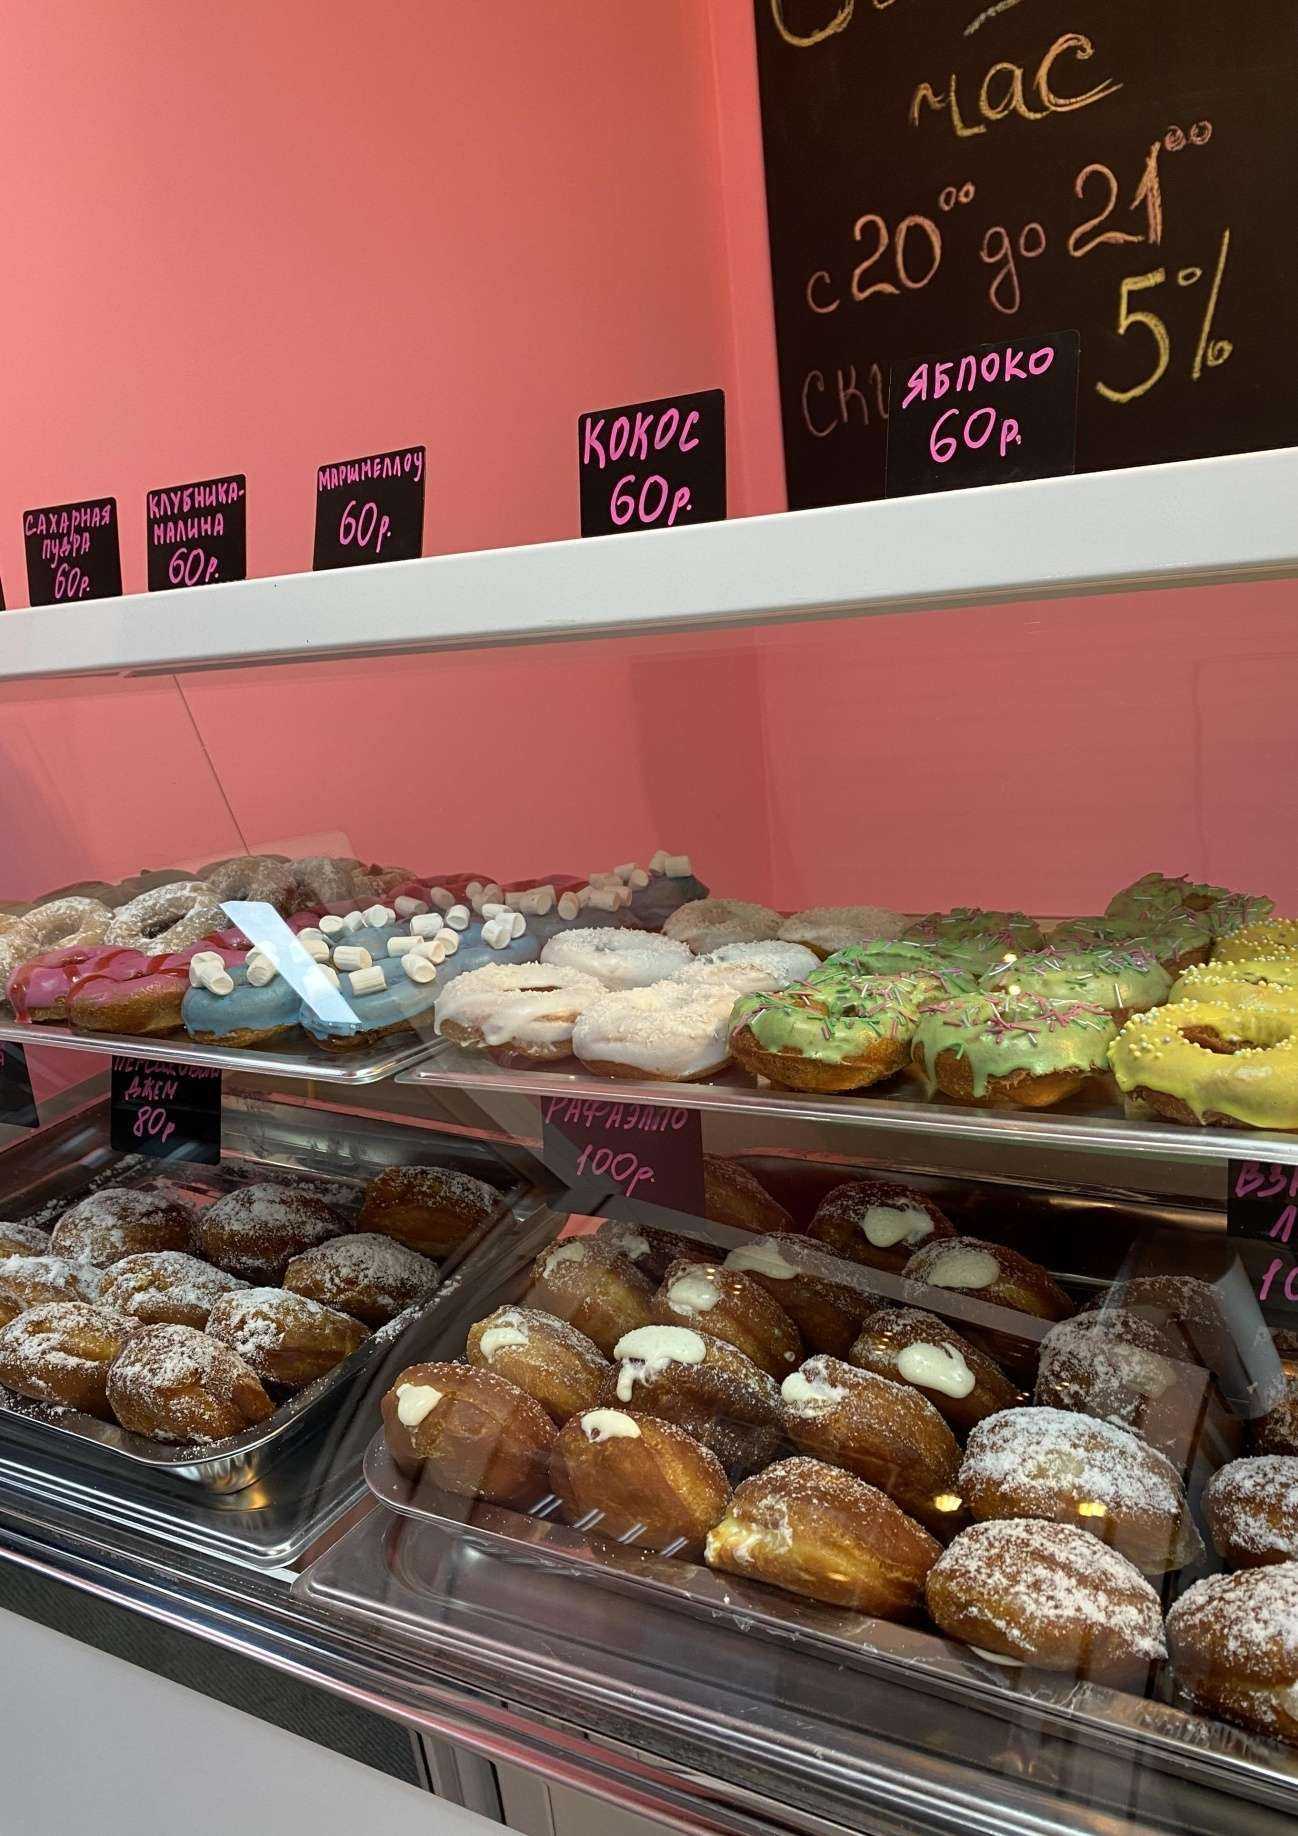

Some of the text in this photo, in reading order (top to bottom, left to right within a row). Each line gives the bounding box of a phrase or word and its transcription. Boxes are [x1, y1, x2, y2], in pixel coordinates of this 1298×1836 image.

[1096, 227, 1233, 402] 5%
[902, 347, 1054, 409] ЯБЛОКО
[583, 407, 700, 469] КОКОС
[319, 451, 423, 491] МАРШМЕЛЛОУ
[25, 504, 112, 541] САХАРНАЯ
[154, 512, 224, 546] МАЛИНА
[42, 532, 91, 568] ПУДРА
[124, 1076, 178, 1100] ДЖЕМ
